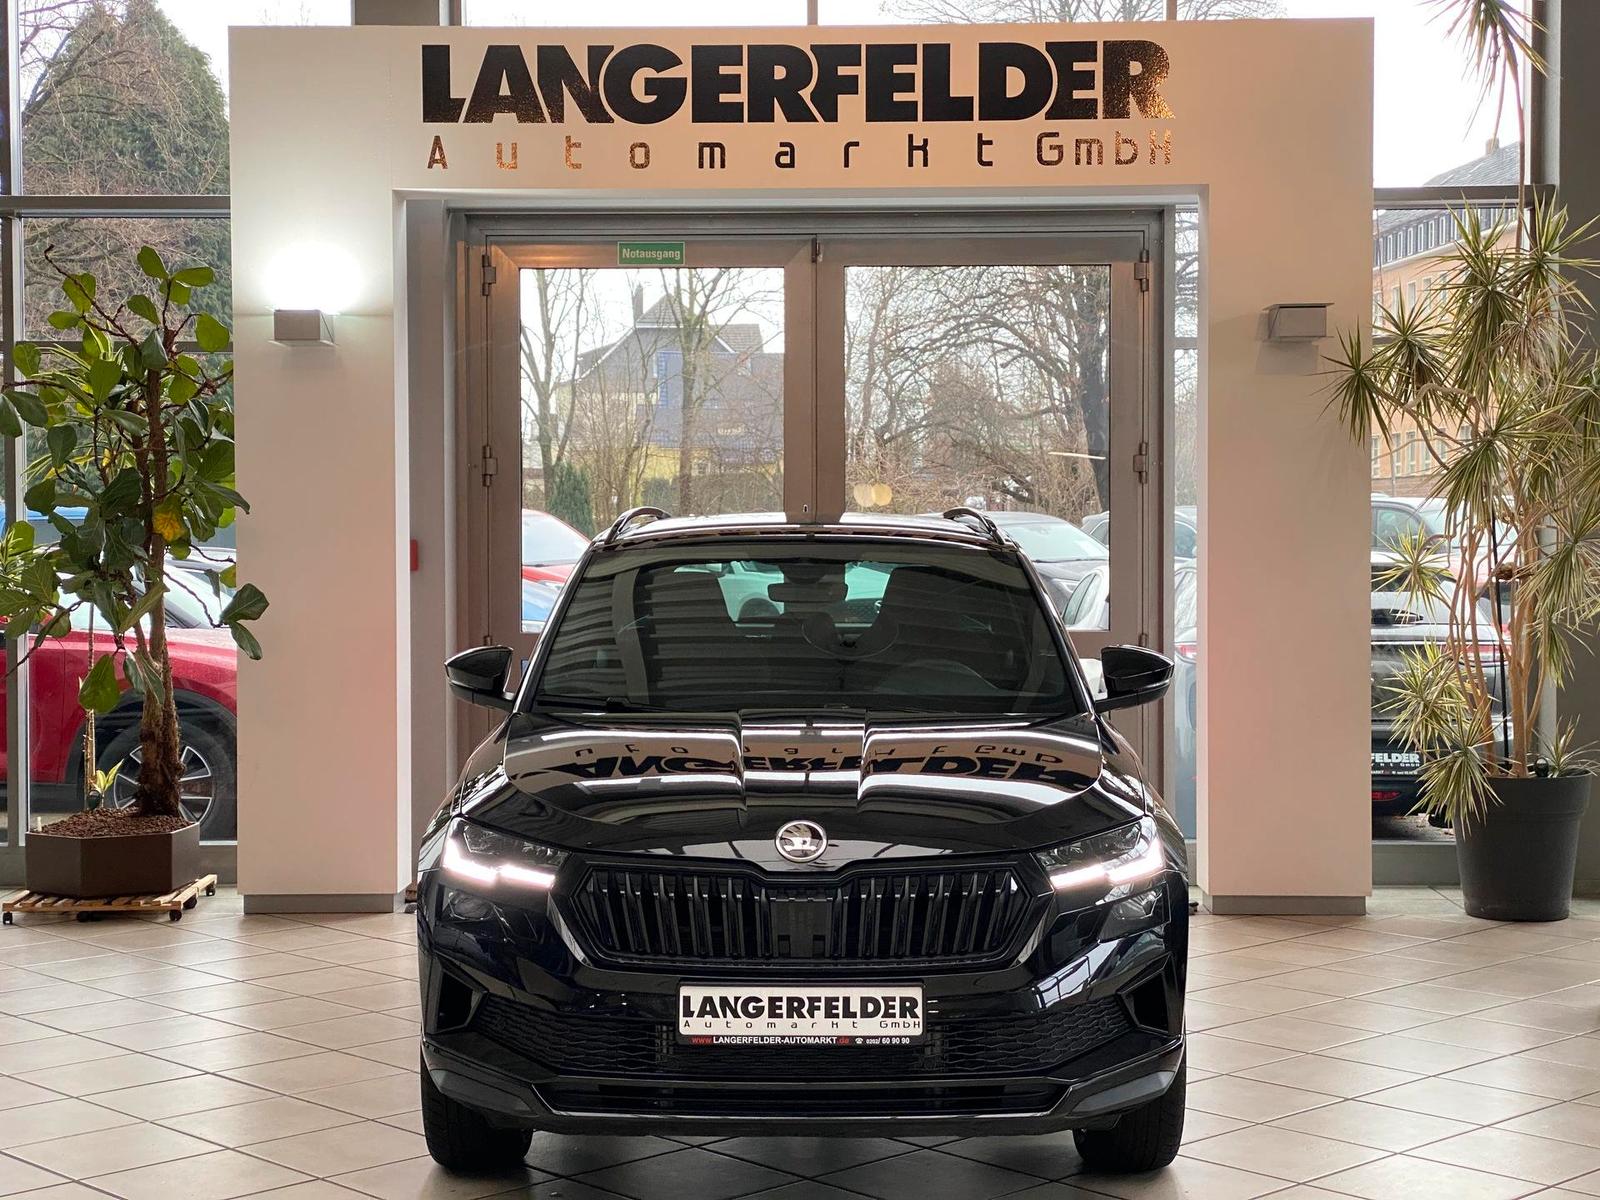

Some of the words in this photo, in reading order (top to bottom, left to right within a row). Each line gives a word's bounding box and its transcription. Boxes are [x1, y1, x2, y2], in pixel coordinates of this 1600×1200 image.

[421, 40, 1176, 125] LANGERFELDER
[1036, 129, 1173, 167] GmbH
[622, 248, 681, 261] Notausgang
[682, 995, 920, 1019] LANGERFELDER
[879, 1020, 921, 1029] GmbH
